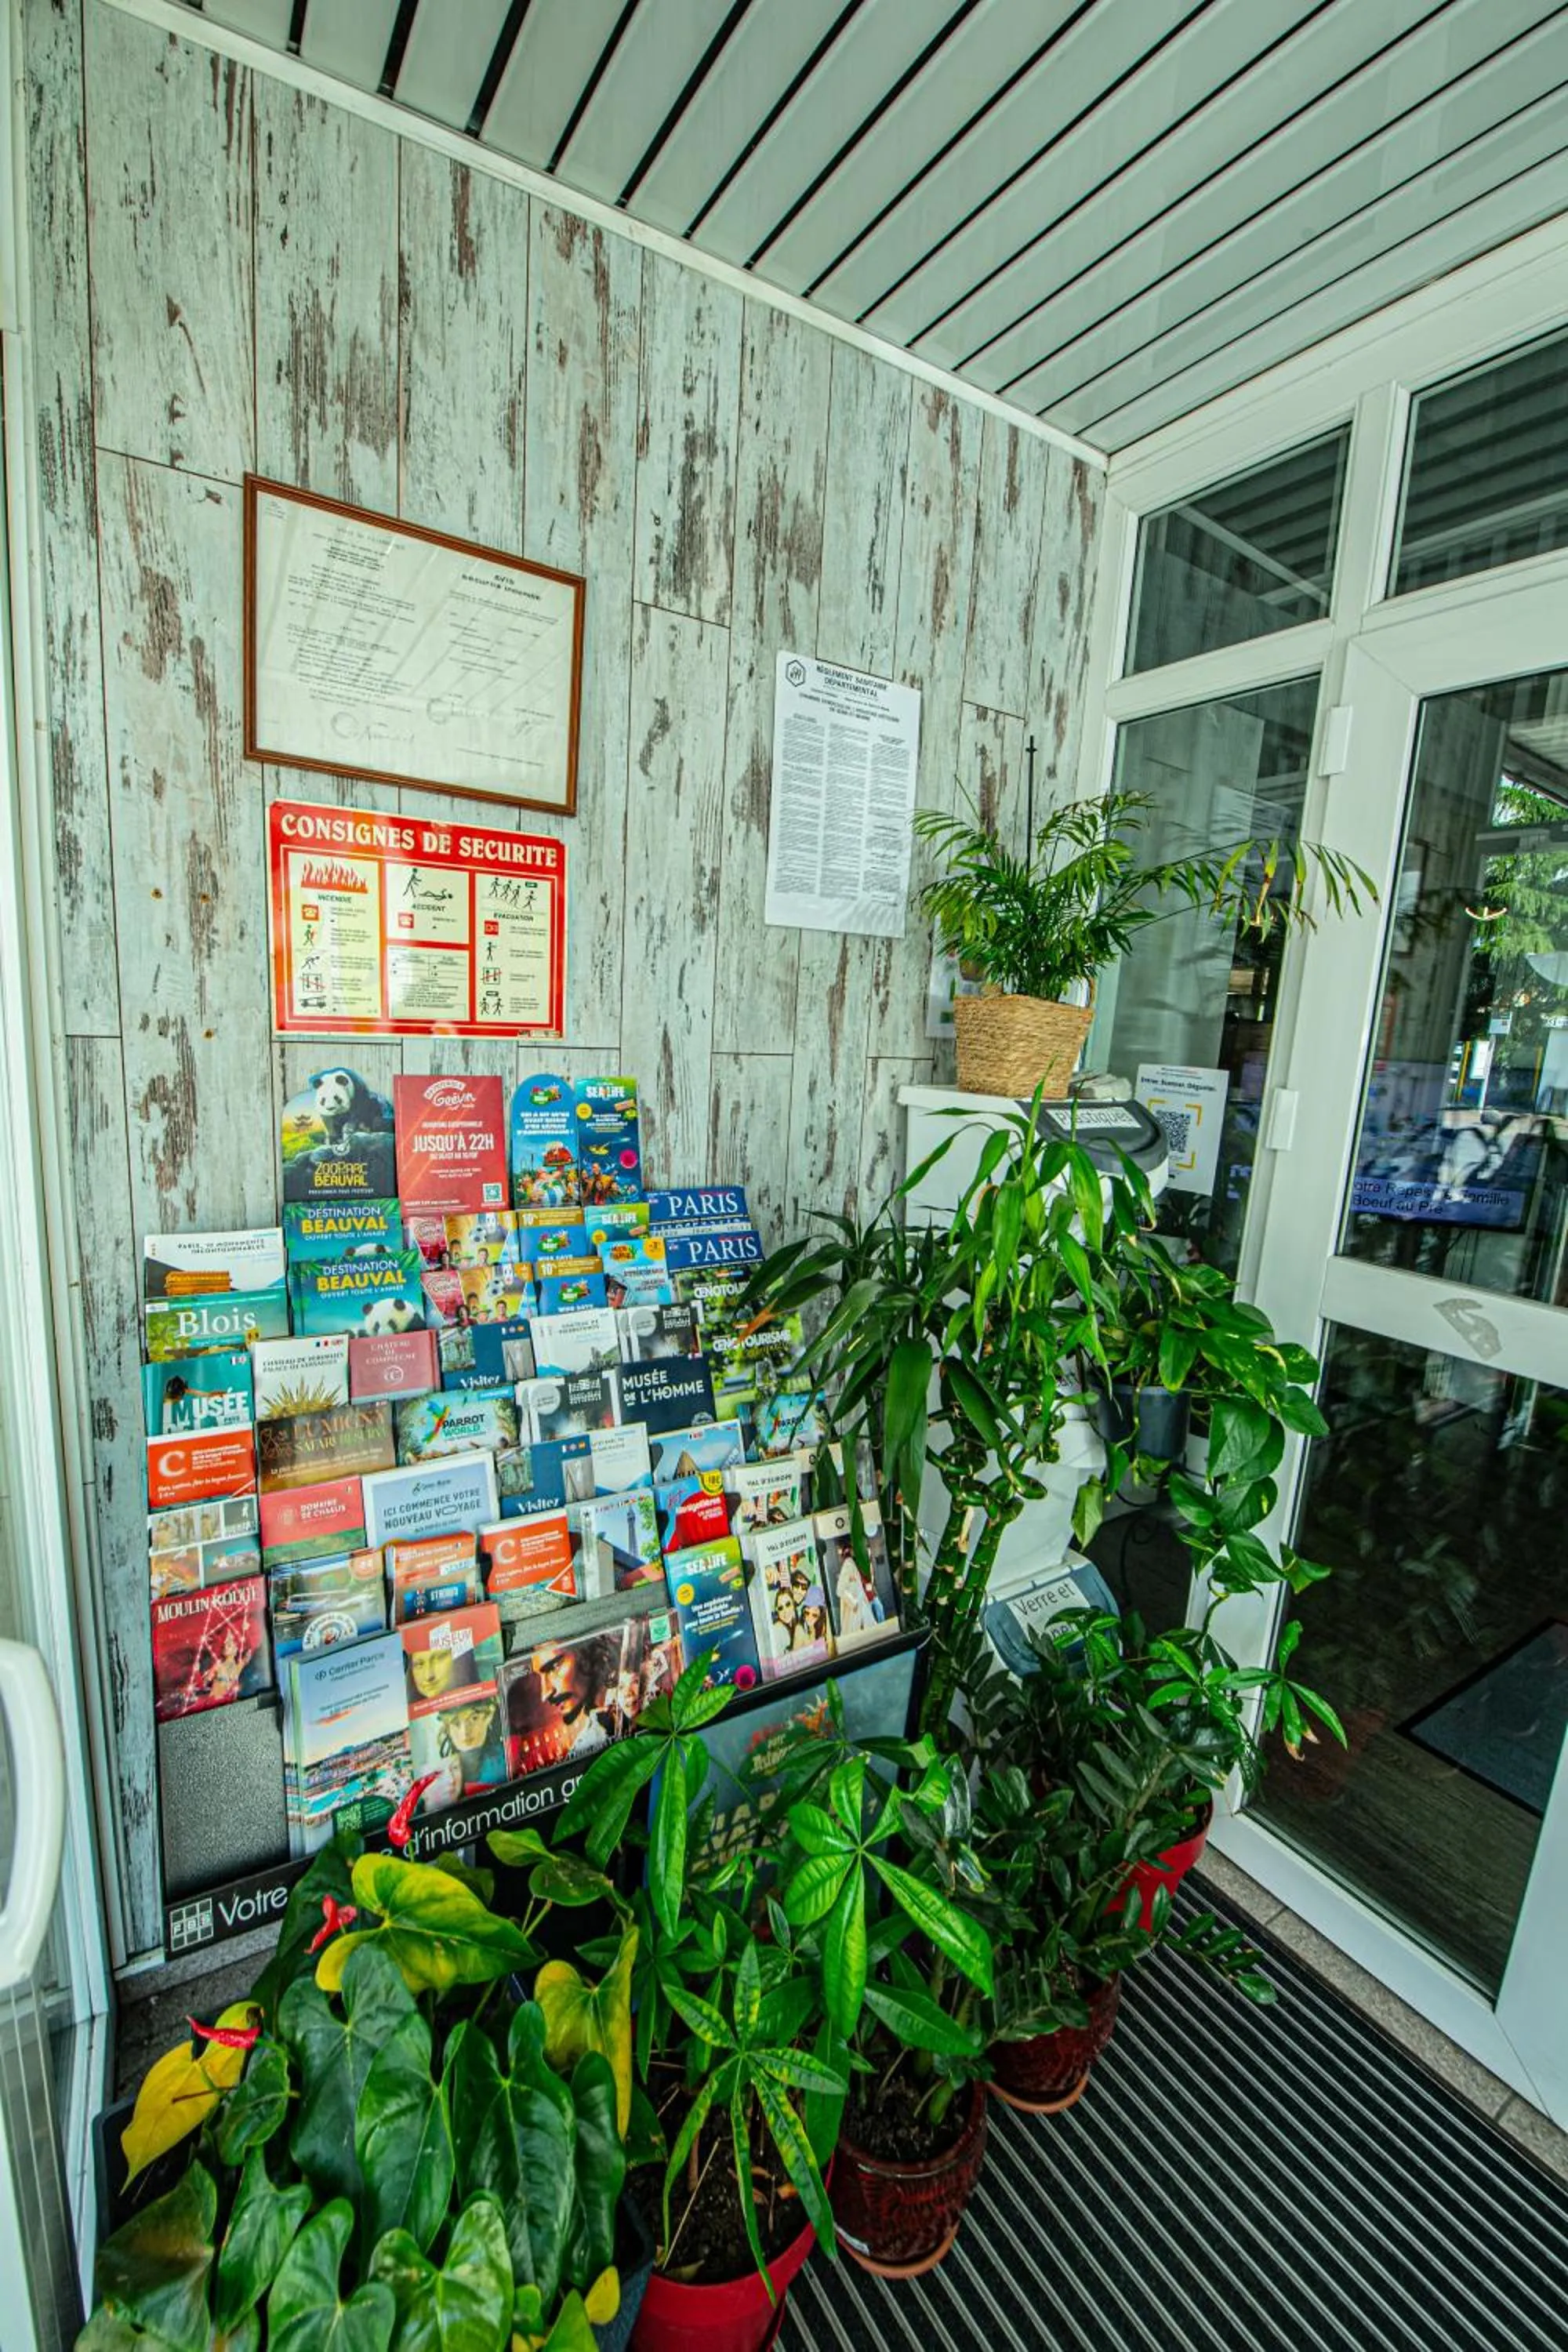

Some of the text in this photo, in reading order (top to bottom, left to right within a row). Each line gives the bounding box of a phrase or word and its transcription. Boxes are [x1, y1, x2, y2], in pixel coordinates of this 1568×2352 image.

[281, 814, 558, 869] CONSIGNES DE SECURITE
[412, 903, 446, 912] ACCIDENT
[493, 913, 534, 922] EVACUATION
[412, 1131, 495, 1153] JUSQU'À 22H
[314, 1174, 368, 1187] BEAUVAL
[308, 1207, 381, 1218] DESTINATION
[667, 1192, 739, 1218] PARIS
[1396, 1201, 1414, 1212] au
[301, 1216, 389, 1233] BEAUVAL
[688, 1236, 759, 1263] PARIS
[322, 1260, 398, 1276] DESTINATION
[316, 1270, 406, 1292] BEAUVAL
[175, 1307, 257, 1338] Blois
[622, 1369, 668, 1390] MUSÉE
[623, 1380, 705, 1404] DE L'HOMME
[441, 1414, 485, 1429] PARROT
[441, 1424, 481, 1438] WORLD
[158, 1450, 187, 1477] C
[746, 1473, 792, 1486] VAL D'EUROPE
[300, 1498, 337, 1510] DOMAINE
[383, 1488, 481, 1518] ICI COMMENCE VOTRE
[385, 1498, 482, 1530] NOUVEAU VOYAGE
[517, 1497, 560, 1514] Visitez
[495, 1538, 517, 1565] C
[766, 1534, 807, 1552] VAL D'EUROPE
[686, 1552, 727, 1576] SEA LIFE
[158, 1596, 210, 1624] MOULIN
[1013, 1581, 1076, 1617] Verre et
[328, 1653, 385, 1676] Center Parcs
[218, 1886, 289, 1926] Votre
[403, 1787, 554, 1858] d'information
